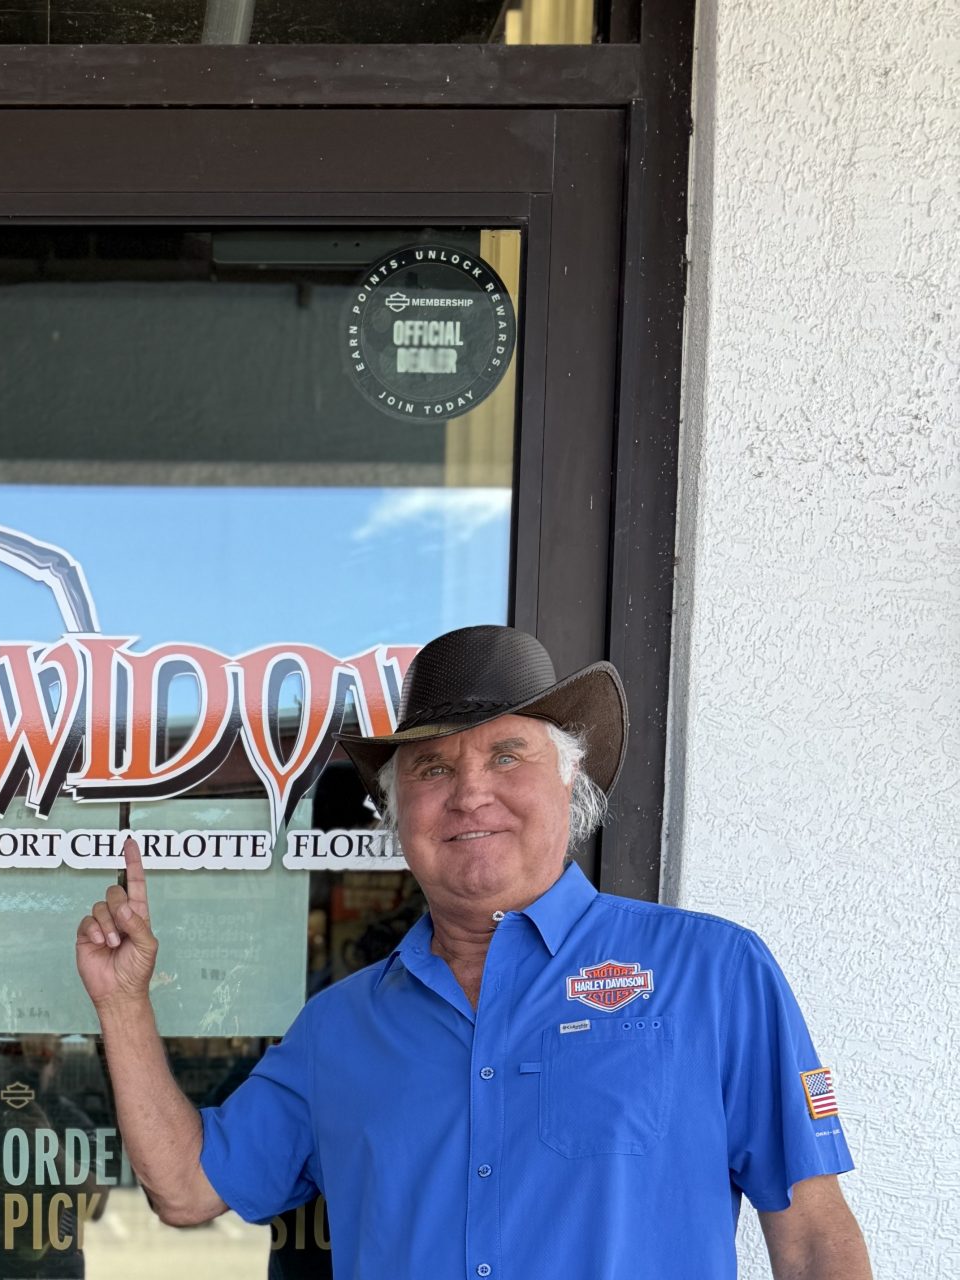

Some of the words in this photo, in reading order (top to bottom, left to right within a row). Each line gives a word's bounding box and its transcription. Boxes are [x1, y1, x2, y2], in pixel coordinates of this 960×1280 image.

[415, 250, 483, 279] UNLOCK
[353, 259, 406, 315] POINTS.
[411, 298, 474, 308] MEMBERSHIP
[393, 319, 464, 346] OFFICIAL
[484, 282, 508, 372] REWARDS.
[349, 325, 365, 372] EARN
[378, 391, 414, 413] JOIN
[424, 390, 474, 414] TODAY
[574, 980, 606, 992] HARLEY
[605, 976, 645, 990] DAVIDSON
